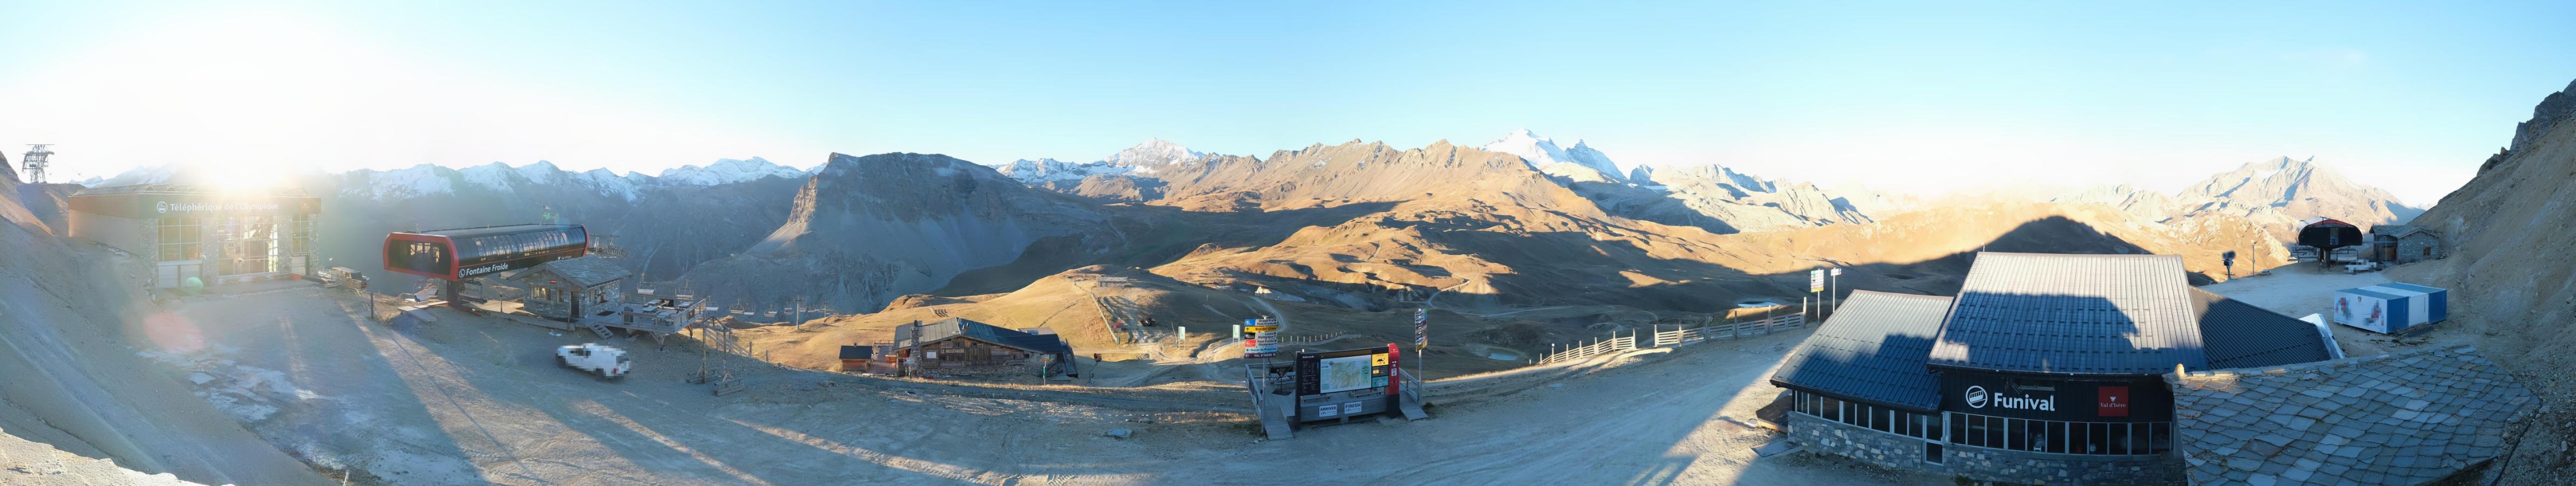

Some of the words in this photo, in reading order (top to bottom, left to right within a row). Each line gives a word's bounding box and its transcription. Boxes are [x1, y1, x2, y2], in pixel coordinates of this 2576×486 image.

[170, 203, 222, 213] Téléphérique
[235, 202, 279, 212] l'Olympique
[466, 266, 491, 276] Fontaine
[492, 262, 508, 272] Froide
[1994, 393, 2055, 411] Funival
